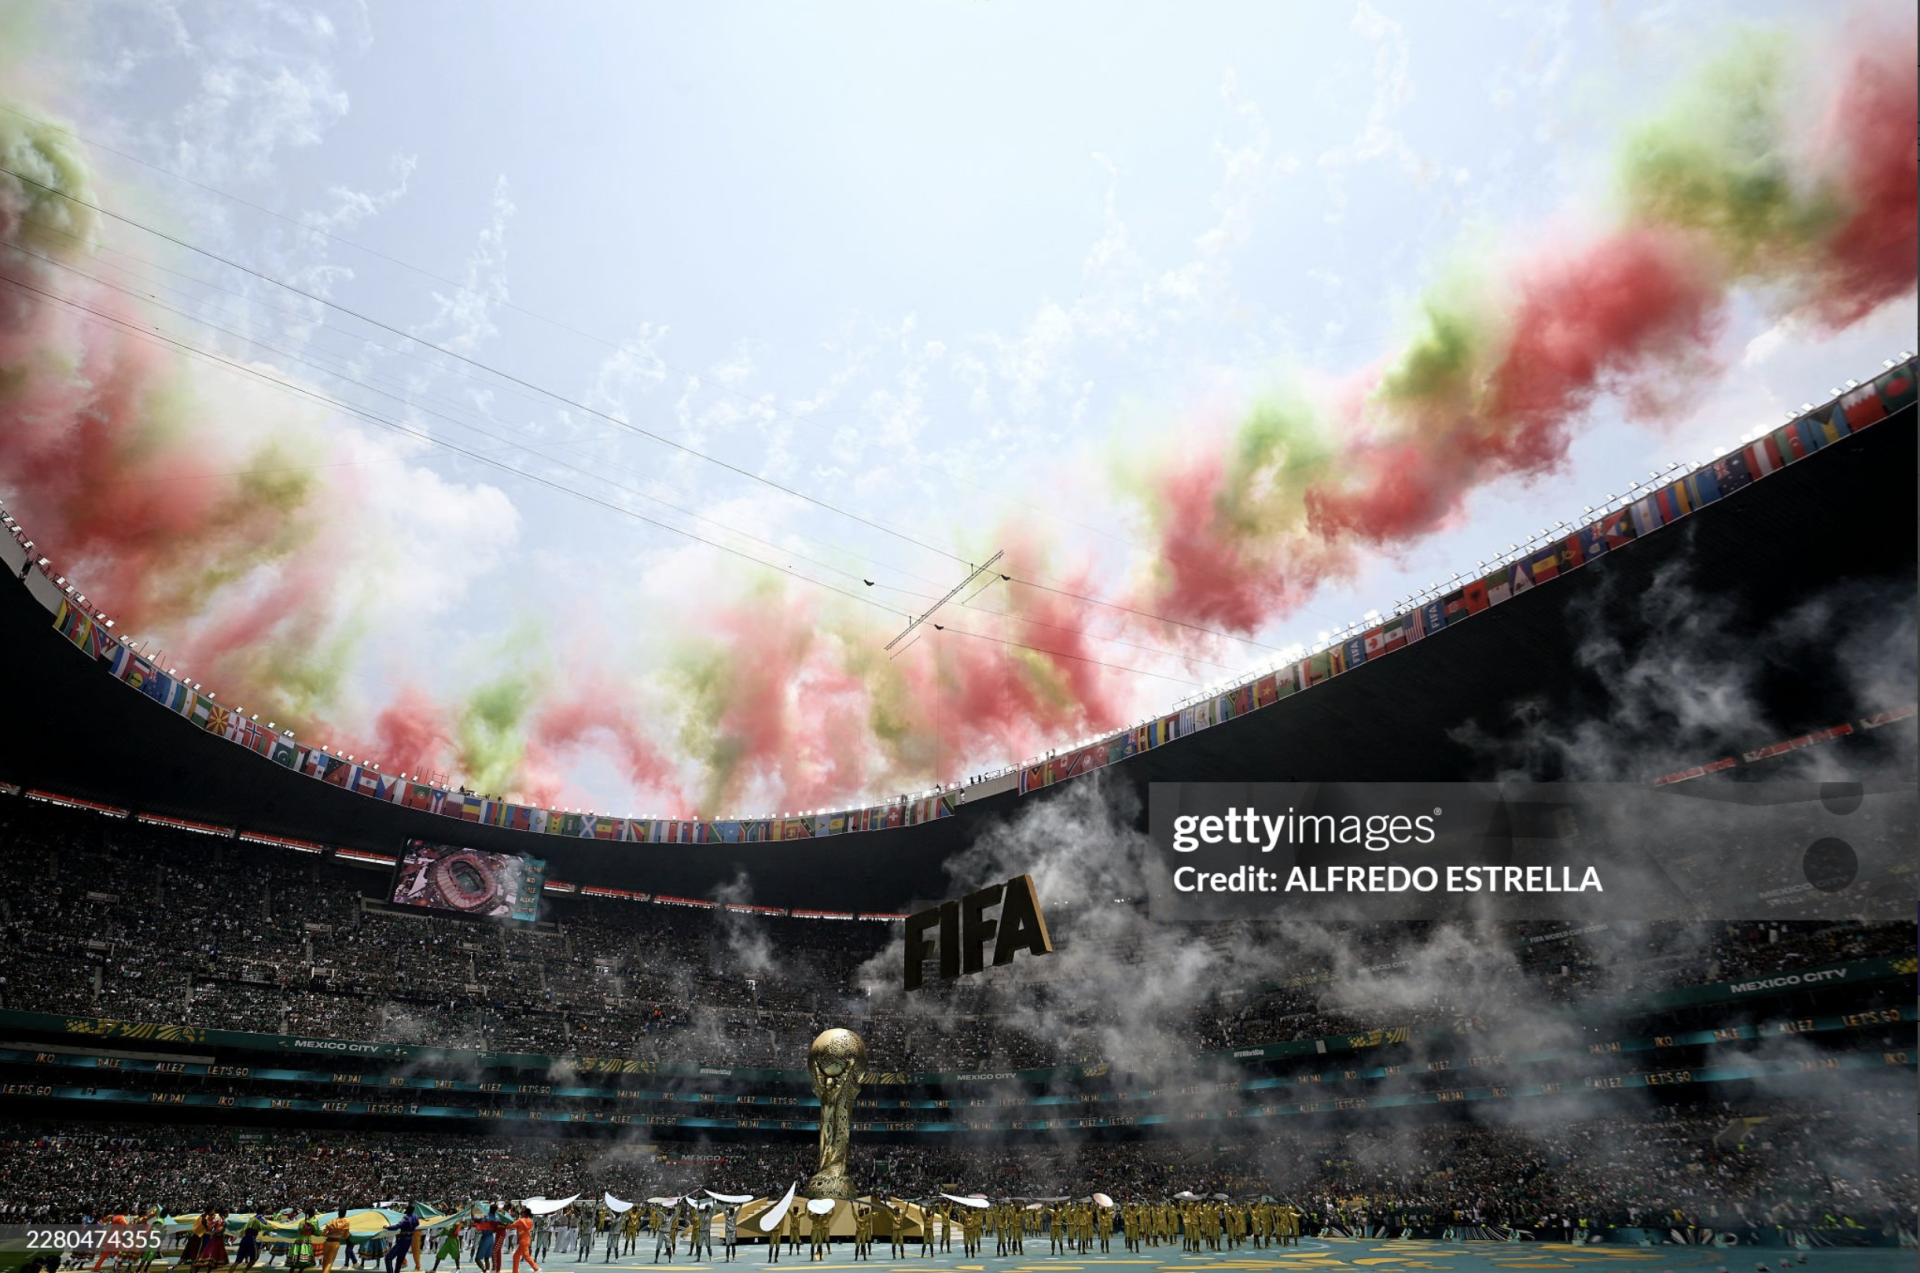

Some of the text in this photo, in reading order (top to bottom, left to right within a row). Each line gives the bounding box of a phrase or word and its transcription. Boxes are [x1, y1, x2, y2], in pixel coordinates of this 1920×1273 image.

[1428, 605, 1440, 629] FIFA
[1350, 641, 1361, 663] FIFA
[1758, 875, 1849, 899] MEXICO CITY
[904, 874, 1053, 992] FIFA
[1529, 935, 1544, 944] FIFA
[1544, 930, 1569, 941] WORLD
[1569, 928, 1583, 937] CUP
[1358, 960, 1413, 973] MEXICO CITY
[1730, 968, 1848, 994] MEXICO CITY
[1841, 1008, 1902, 1027] LET'S GO
[1779, 1019, 1814, 1034] ALLEZ
[1713, 1028, 1740, 1041] DALE
[294, 1040, 379, 1053] MEXICO CITY
[1654, 1036, 1673, 1048] IKO
[36, 1053, 55, 1064] IKO
[97, 1058, 120, 1069] DALE
[1468, 1054, 1505, 1068] LET'S GO
[1883, 1052, 1908, 1065] IKO
[155, 1063, 186, 1074] ALLEZ
[1427, 1060, 1450, 1070] ALLEZ
[207, 1066, 249, 1076] LET'S GO
[1344, 1070, 1357, 1079] IKO
[332, 1074, 361, 1083] DAI DAI
[389, 1078, 404, 1086] IKO
[957, 1073, 993, 1081] MEXICO
[1644, 1070, 1692, 1085] LET'S GO
[435, 1080, 453, 1089] DALE
[479, 1083, 501, 1092] ALLEZ
[1594, 1077, 1624, 1090] ALLEZ
[2, 1085, 52, 1096] LET'S GO
[518, 1085, 539, 1093] LET'S
[1492, 1087, 1507, 1097] IKO
[152, 1093, 186, 1103] DAI DAI
[218, 1096, 235, 1106] IKO
[737, 1096, 755, 1104] ALLEZ
[770, 1097, 787, 1105] LET'S
[270, 1100, 291, 1109] DALE
[321, 1102, 347, 1112] ALLEZ
[367, 1104, 390, 1113] LET'S
[1335, 1100, 1354, 1110] LET'S
[528, 1112, 542, 1120] IKO
[570, 1113, 587, 1122] DALE
[610, 1115, 631, 1124] ALLEZ
[646, 1116, 665, 1125] LET'S
[853, 1123, 872, 1131] ALLEZ
[886, 1123, 903, 1131] LET'S
[1079, 1119, 1096, 1127] ALLEZ
[681, 1154, 721, 1162] MEXICO
